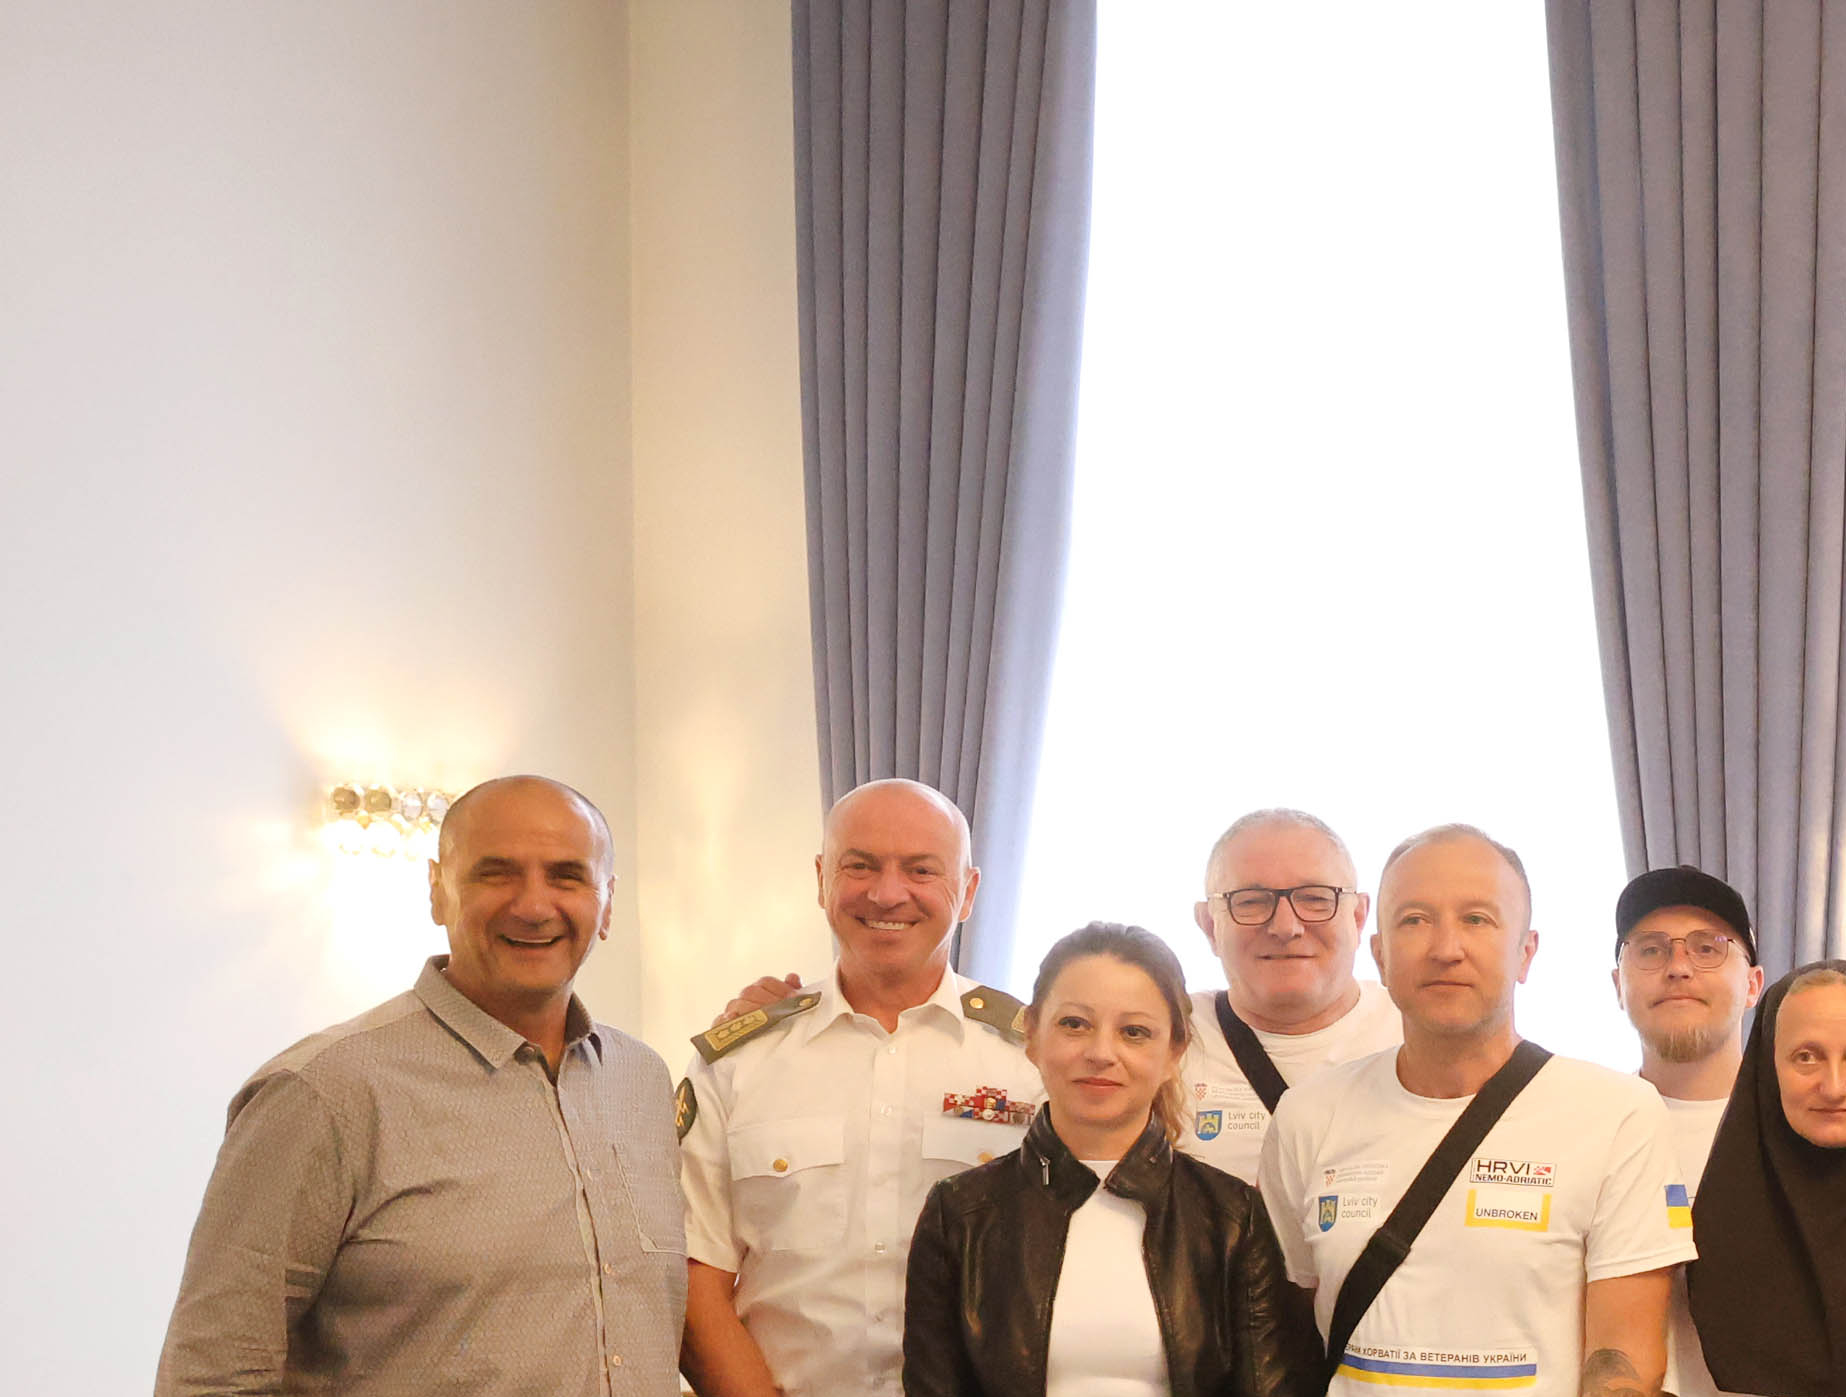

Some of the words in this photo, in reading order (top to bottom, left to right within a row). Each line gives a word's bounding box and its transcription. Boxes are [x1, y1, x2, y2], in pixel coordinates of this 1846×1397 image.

[1228, 1111, 1246, 1121] Lviv
[1249, 1111, 1266, 1122] city
[1228, 1121, 1260, 1130] council
[1476, 1159, 1531, 1176] HRVI
[1475, 1174, 1552, 1186] NEMO-ADRIATIC
[1342, 1196, 1359, 1207] Lviv
[1361, 1196, 1379, 1208] city
[1341, 1207, 1372, 1218] council
[1475, 1207, 1539, 1221] UNBROKEN
[1402, 1352, 1417, 1361] ЗА
[1420, 1352, 1480, 1364] ВЕТЕРАНІВ
[1483, 1352, 1527, 1364] УКРАЇНИ
